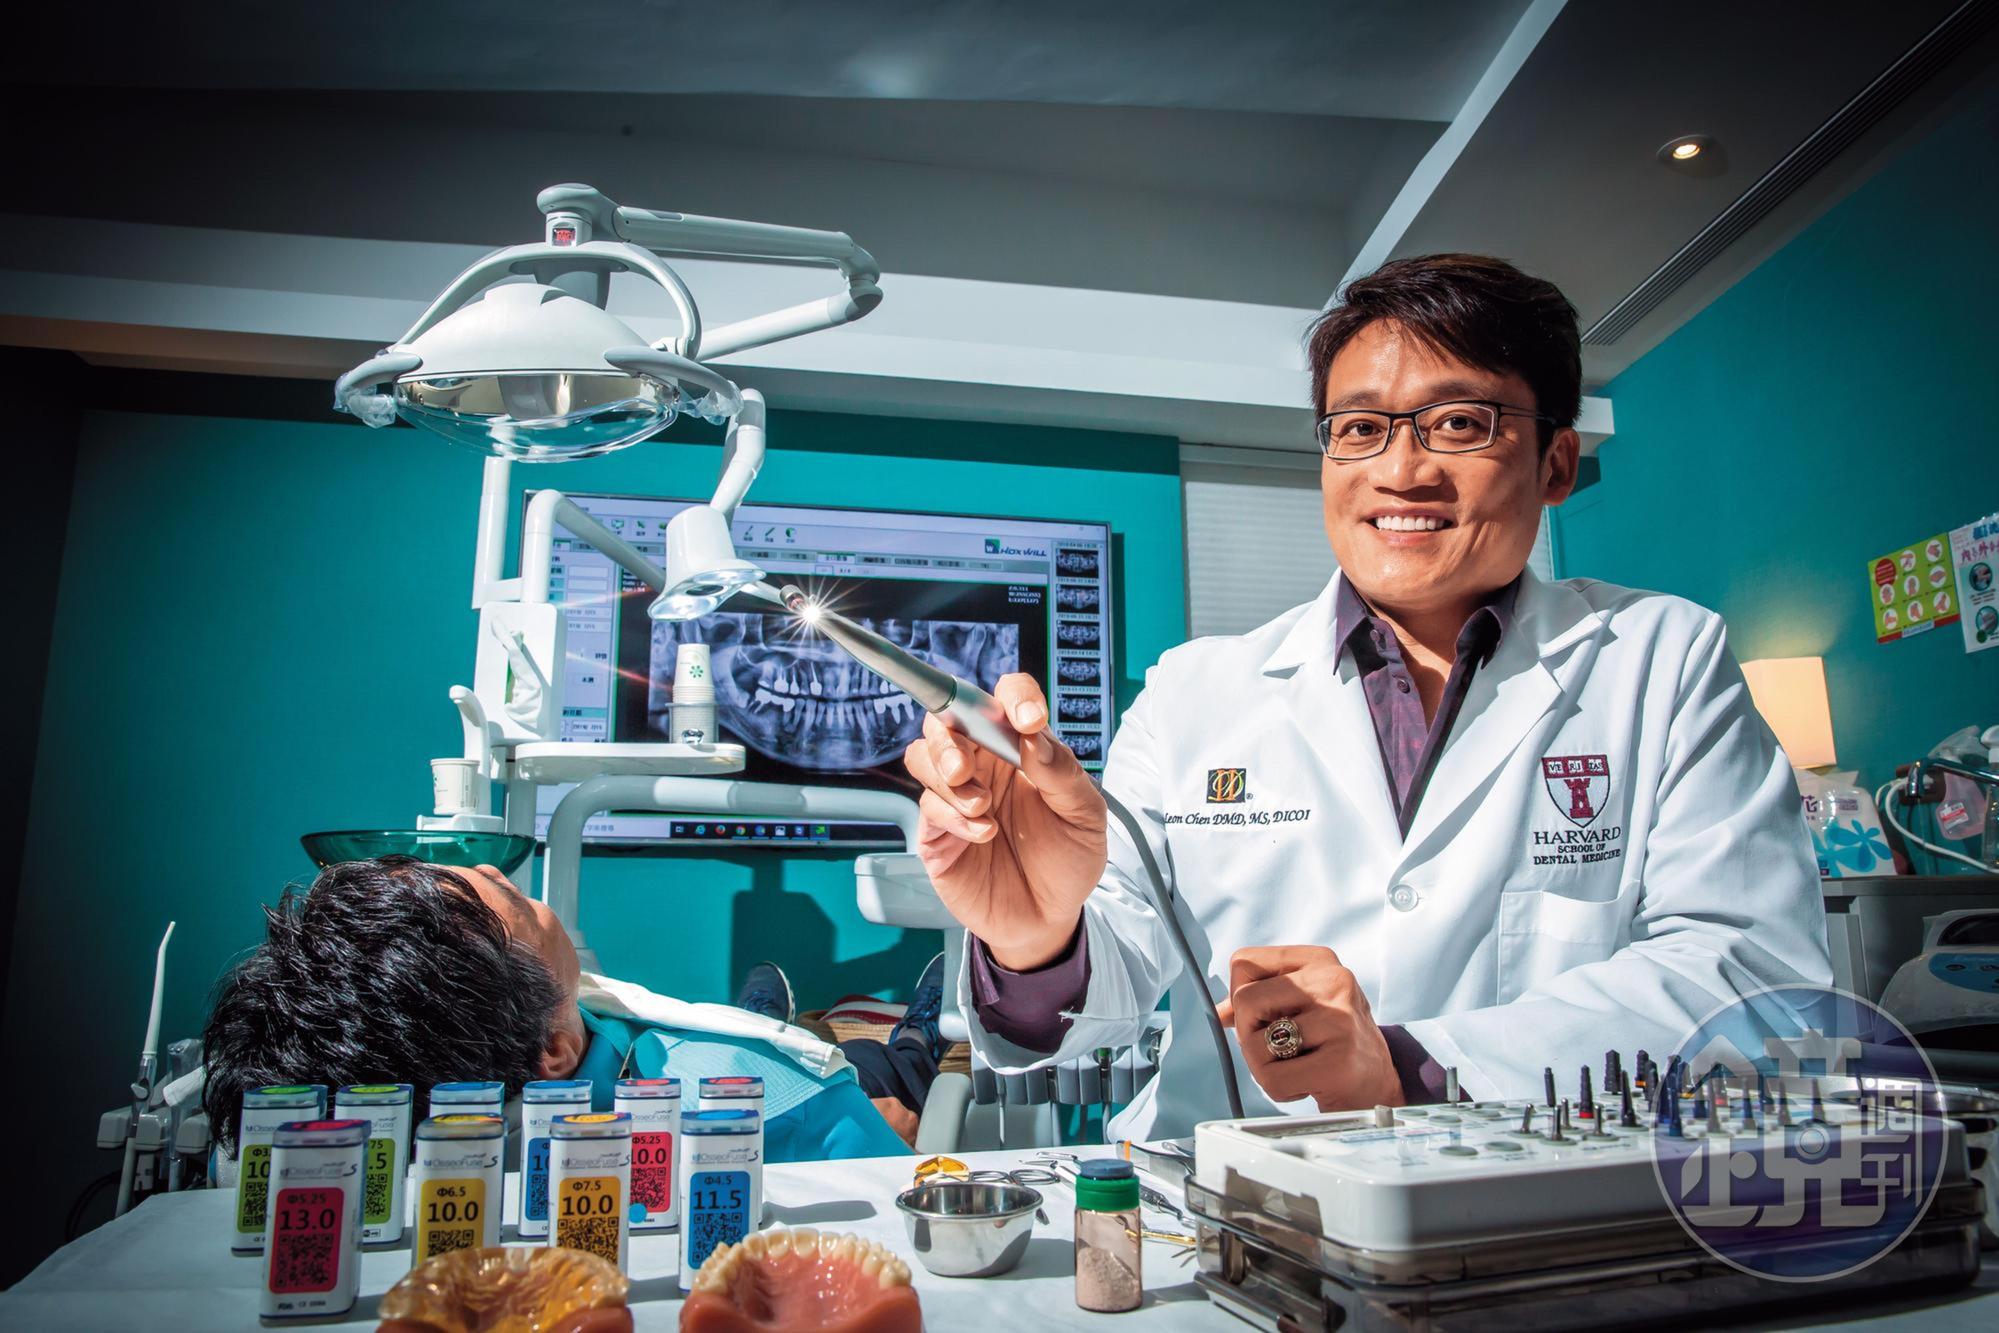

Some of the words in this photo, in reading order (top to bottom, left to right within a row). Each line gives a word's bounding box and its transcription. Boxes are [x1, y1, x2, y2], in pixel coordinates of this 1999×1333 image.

[1185, 812, 1211, 825] Chen
[1249, 811, 1271, 826] MS,
[1533, 826, 1621, 845] HARVARD
[1533, 854, 1578, 865] DENTAL
[1582, 848, 1621, 863] MEDICINE
[1557, 844, 1595, 853] SCHOOL
[1596, 843, 1606, 851] OF
[562, 1194, 614, 1216] 10.0
[693, 1189, 742, 1210] 11.5
[280, 1208, 335, 1231] 13.0
[427, 1200, 479, 1223] 10.0
